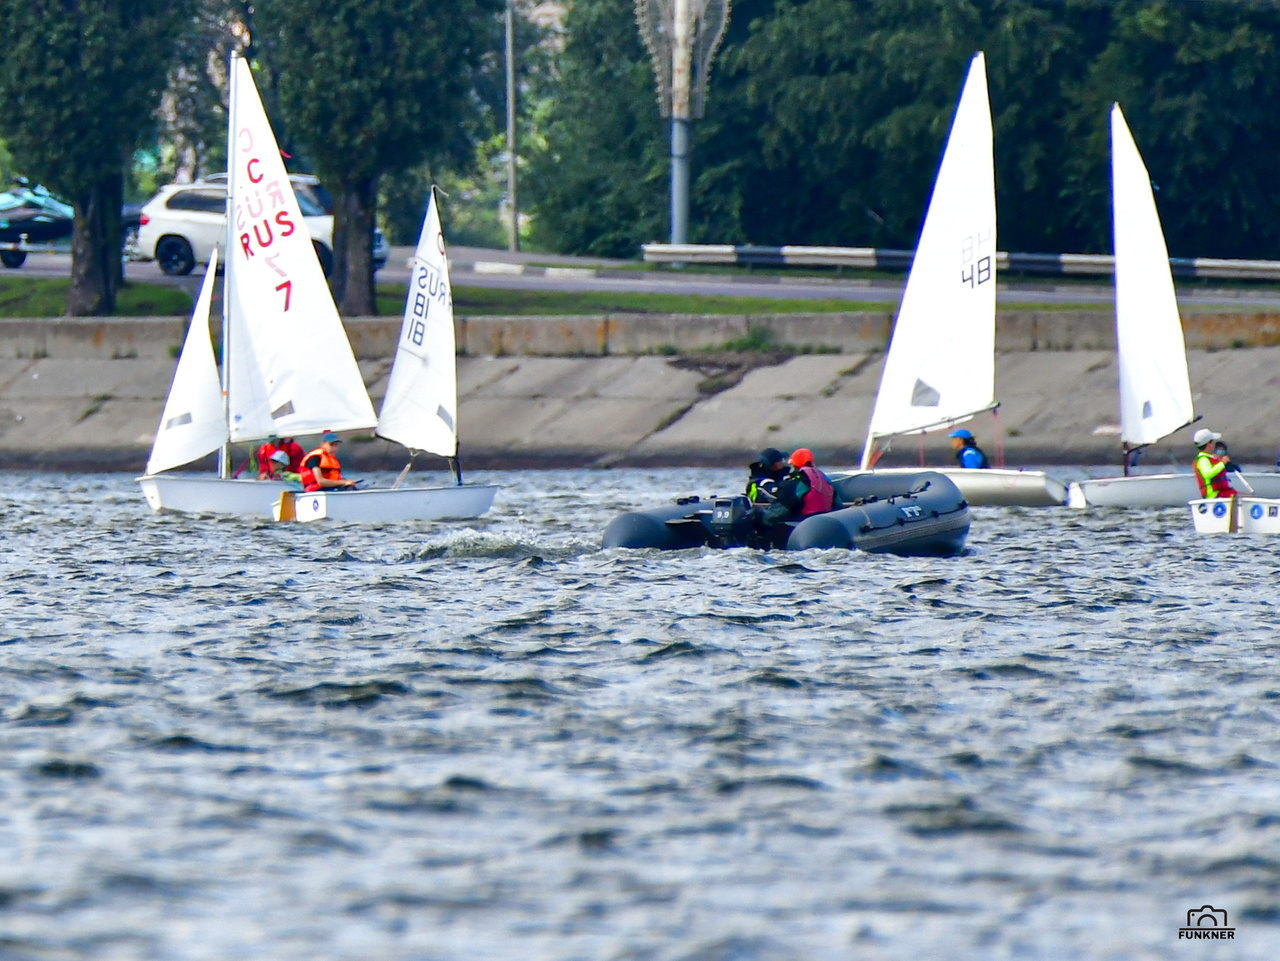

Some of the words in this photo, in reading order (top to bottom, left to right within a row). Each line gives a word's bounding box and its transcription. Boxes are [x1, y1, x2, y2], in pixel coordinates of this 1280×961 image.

[240, 210, 295, 261] RUS
[962, 255, 991, 289] 48
[275, 280, 292, 312] 7
